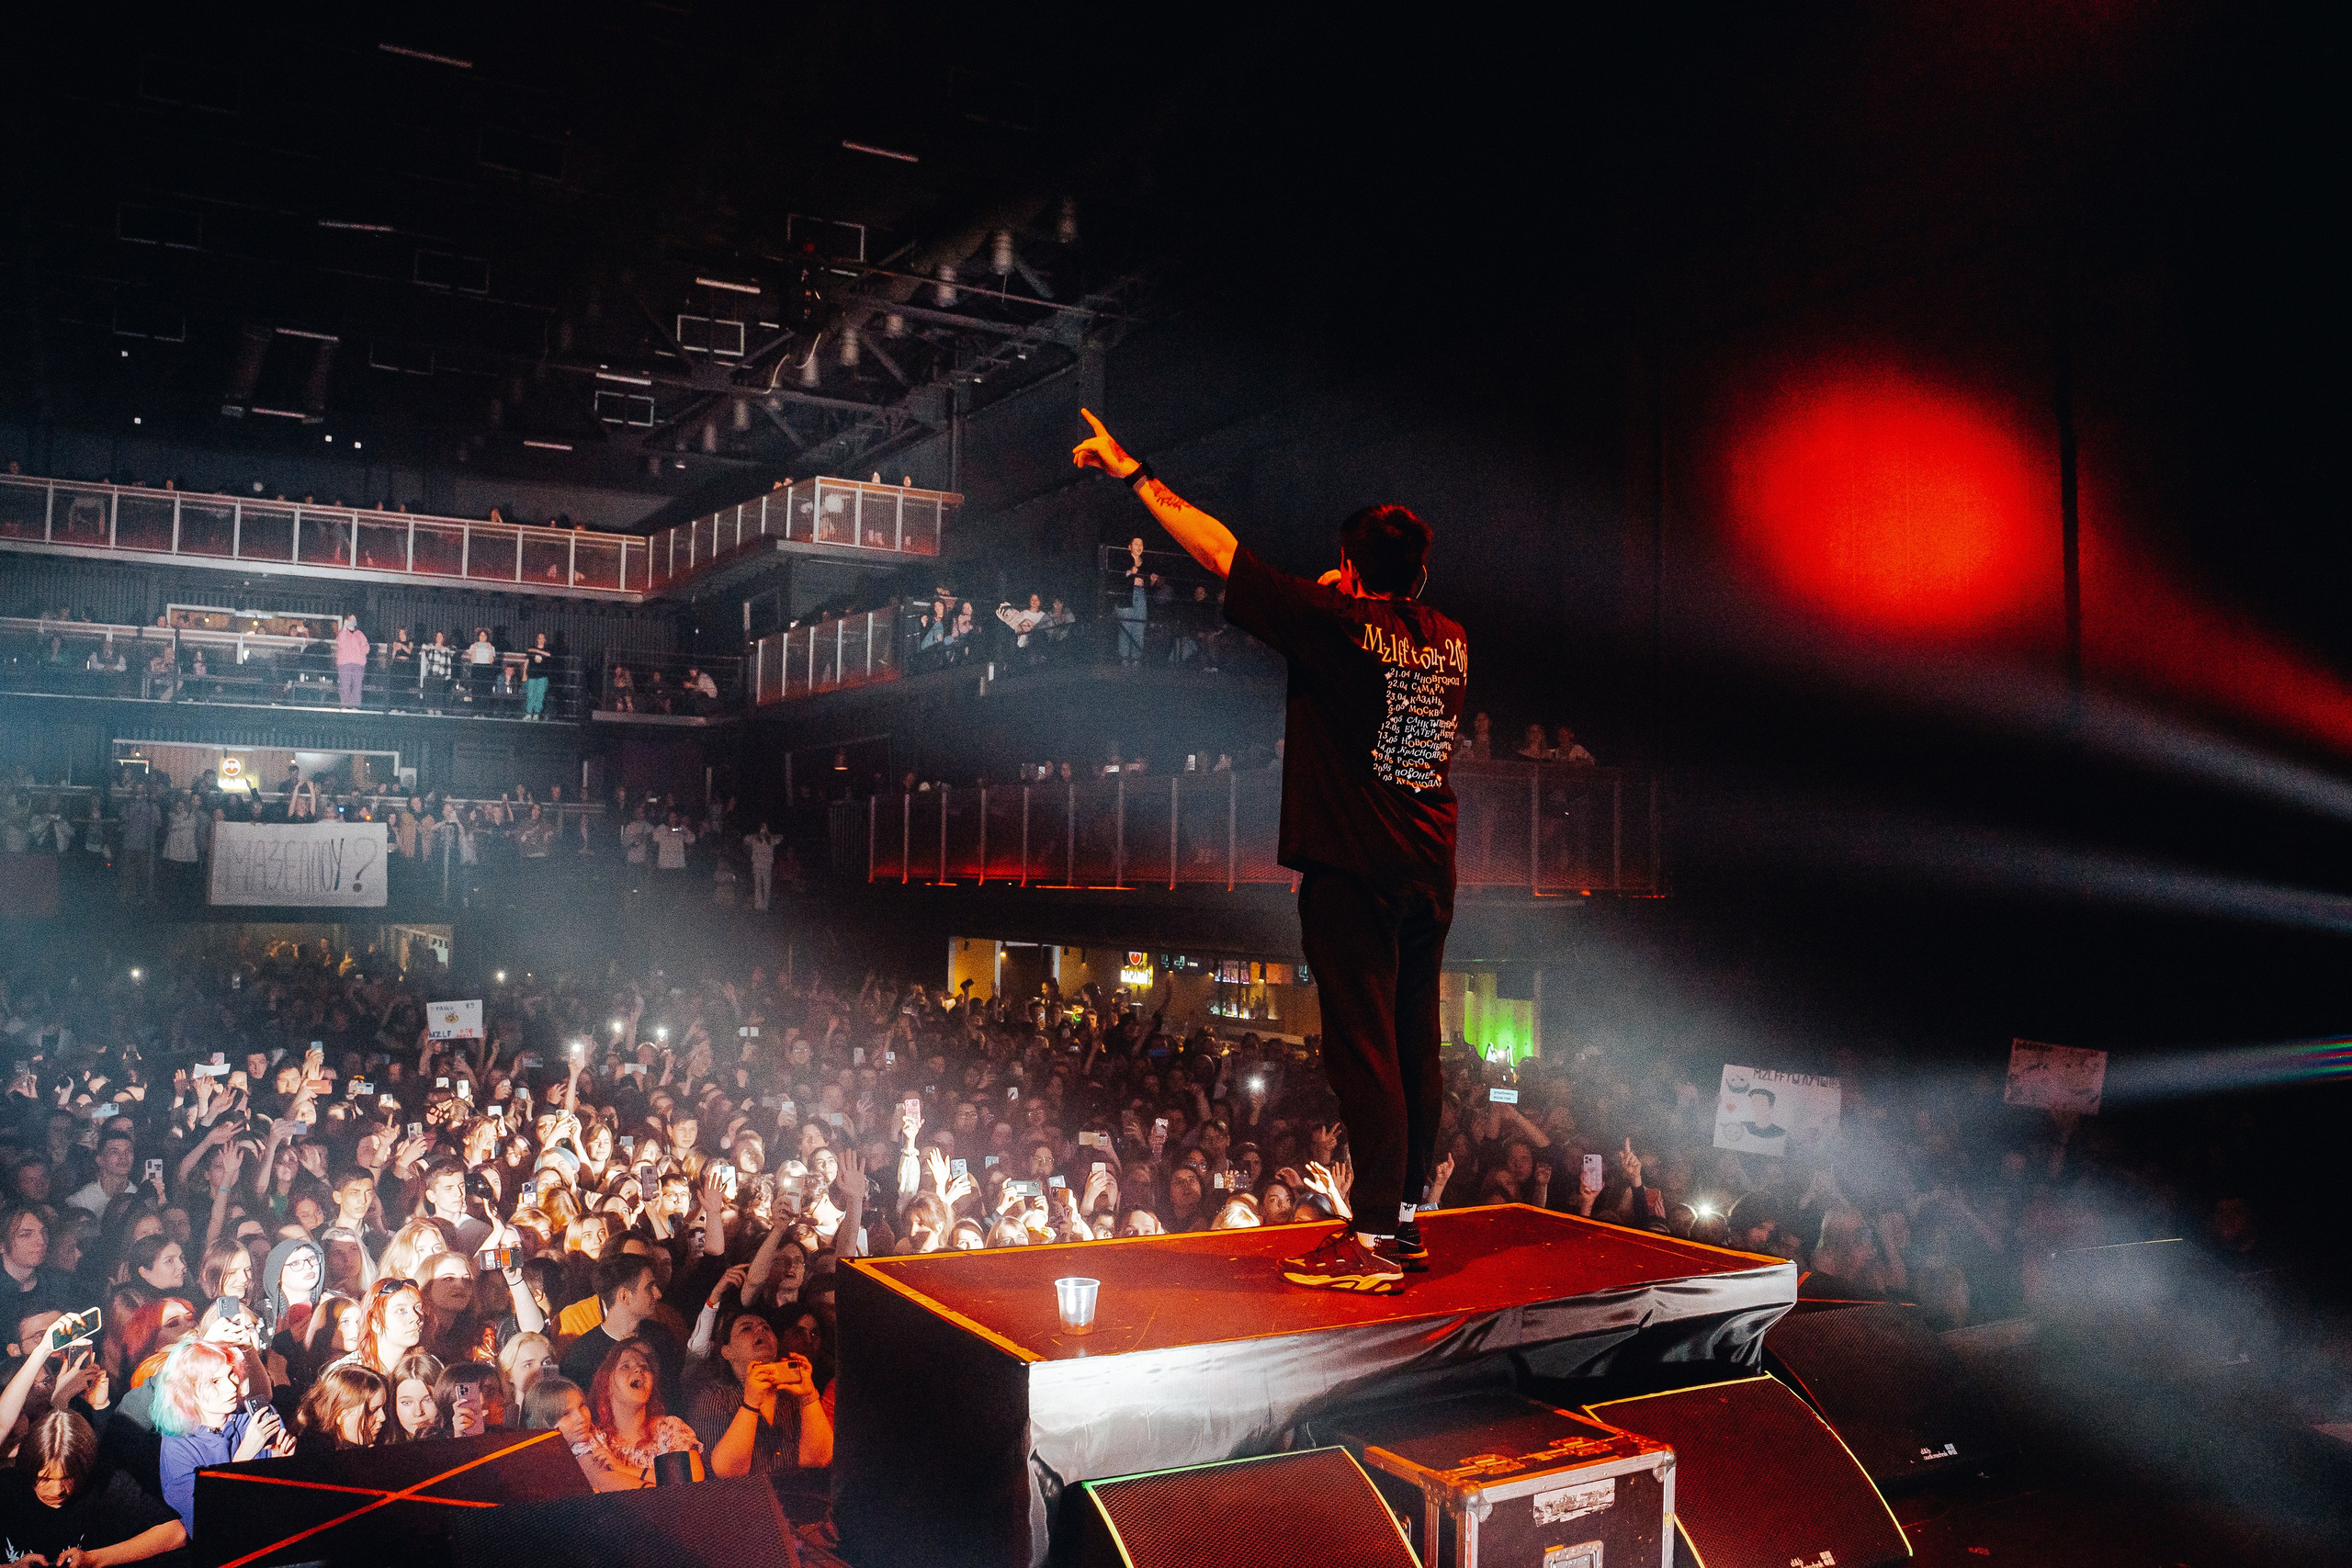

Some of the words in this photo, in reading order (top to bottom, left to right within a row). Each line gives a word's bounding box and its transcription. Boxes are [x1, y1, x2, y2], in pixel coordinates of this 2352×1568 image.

[1362, 624, 1409, 667] Mzlff
[1411, 647, 1445, 672] tour
[1391, 668, 1410, 678] 21.04
[1387, 680, 1408, 691] 22.04
[1411, 682, 1444, 694] САМАРА
[1385, 690, 1407, 702] 23.04
[1409, 694, 1442, 706] КАЗАНЬ
[1408, 705, 1444, 716] МОСКВА
[1381, 720, 1400, 734] 12.05
[1378, 730, 1397, 744] 13.05
[1377, 739, 1396, 754] 14.05
[1396, 756, 1430, 770] РОСТОВ
